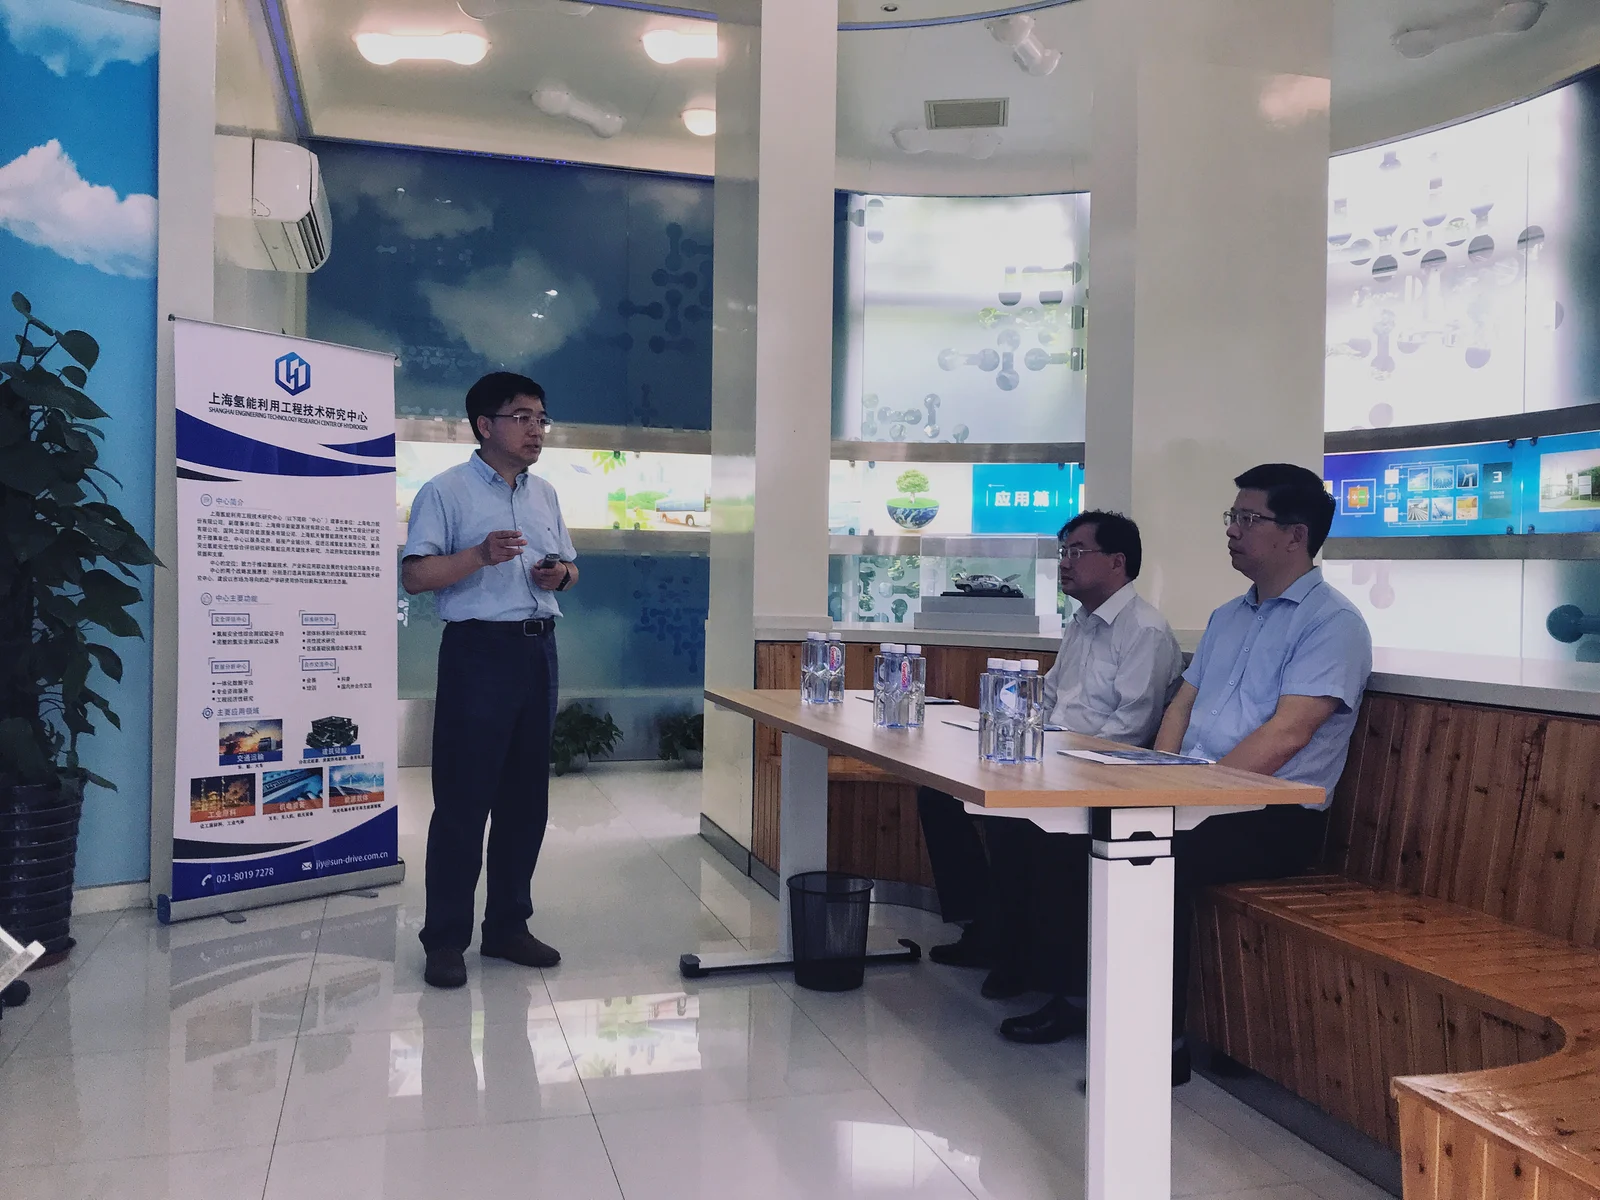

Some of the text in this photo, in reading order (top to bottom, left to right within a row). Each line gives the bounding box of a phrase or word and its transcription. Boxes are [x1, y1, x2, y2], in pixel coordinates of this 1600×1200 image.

[208, 392, 368, 423] 上海氢能利用工程技术研究中心
[208, 406, 235, 416] SHANGHAI
[236, 409, 266, 419] ENGINEERING
[267, 412, 298, 422] TECHNOLOGY
[298, 416, 321, 425] RESEARCH
[321, 419, 337, 428] CENTER
[343, 422, 368, 430] HYDROGEN
[994, 490, 1050, 508] 应用篇
[216, 867, 274, 884] 021-8019 7278
